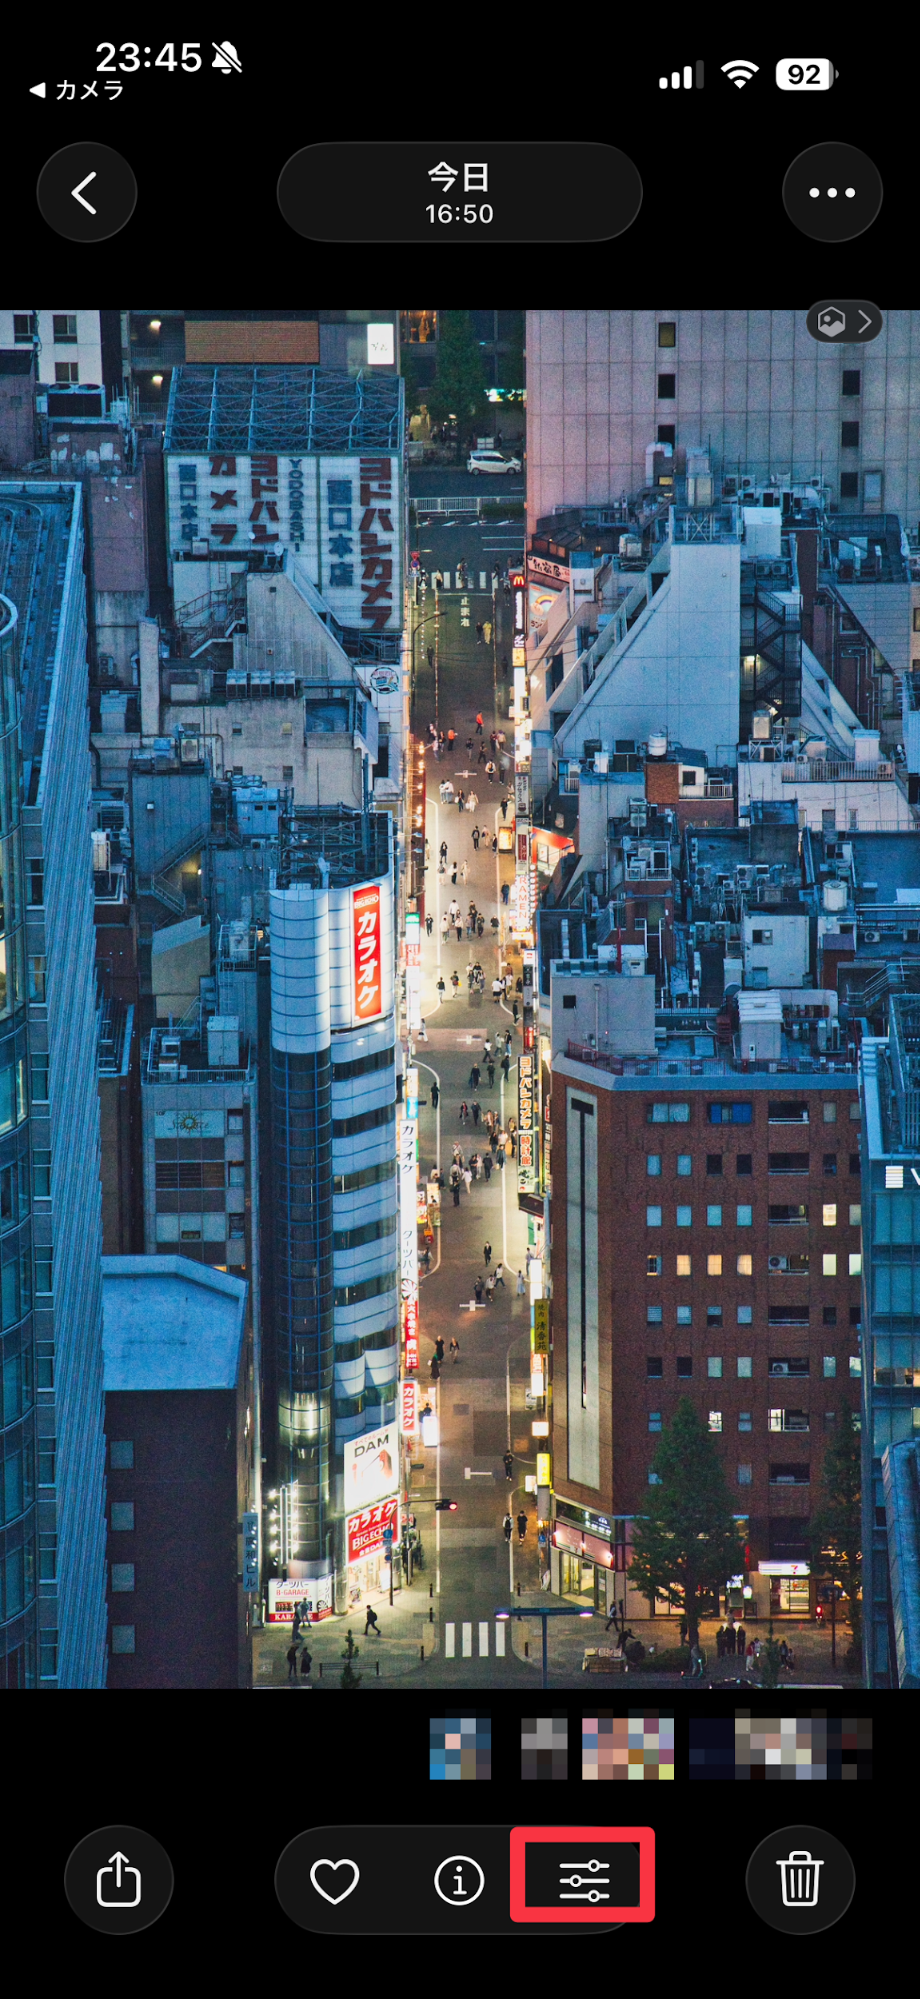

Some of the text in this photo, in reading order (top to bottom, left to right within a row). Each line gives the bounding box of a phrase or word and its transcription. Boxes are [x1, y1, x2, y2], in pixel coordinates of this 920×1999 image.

[208, 455, 238, 545] カメラ
[288, 458, 305, 552] YODOBASHI
[326, 479, 354, 587] 西口本店
[358, 457, 394, 629] ヨドバシカメラ
[518, 876, 528, 919] RAMEN
[356, 910, 379, 1010] カラオケ
[519, 1056, 532, 1130] ヨドバシカメラ
[402, 1124, 415, 1175] カラオケ
[403, 1386, 415, 1428] カラオケ
[354, 1433, 389, 1458] DAM
[348, 1500, 397, 1535] カラオケ
[352, 1532, 370, 1551] BIG
